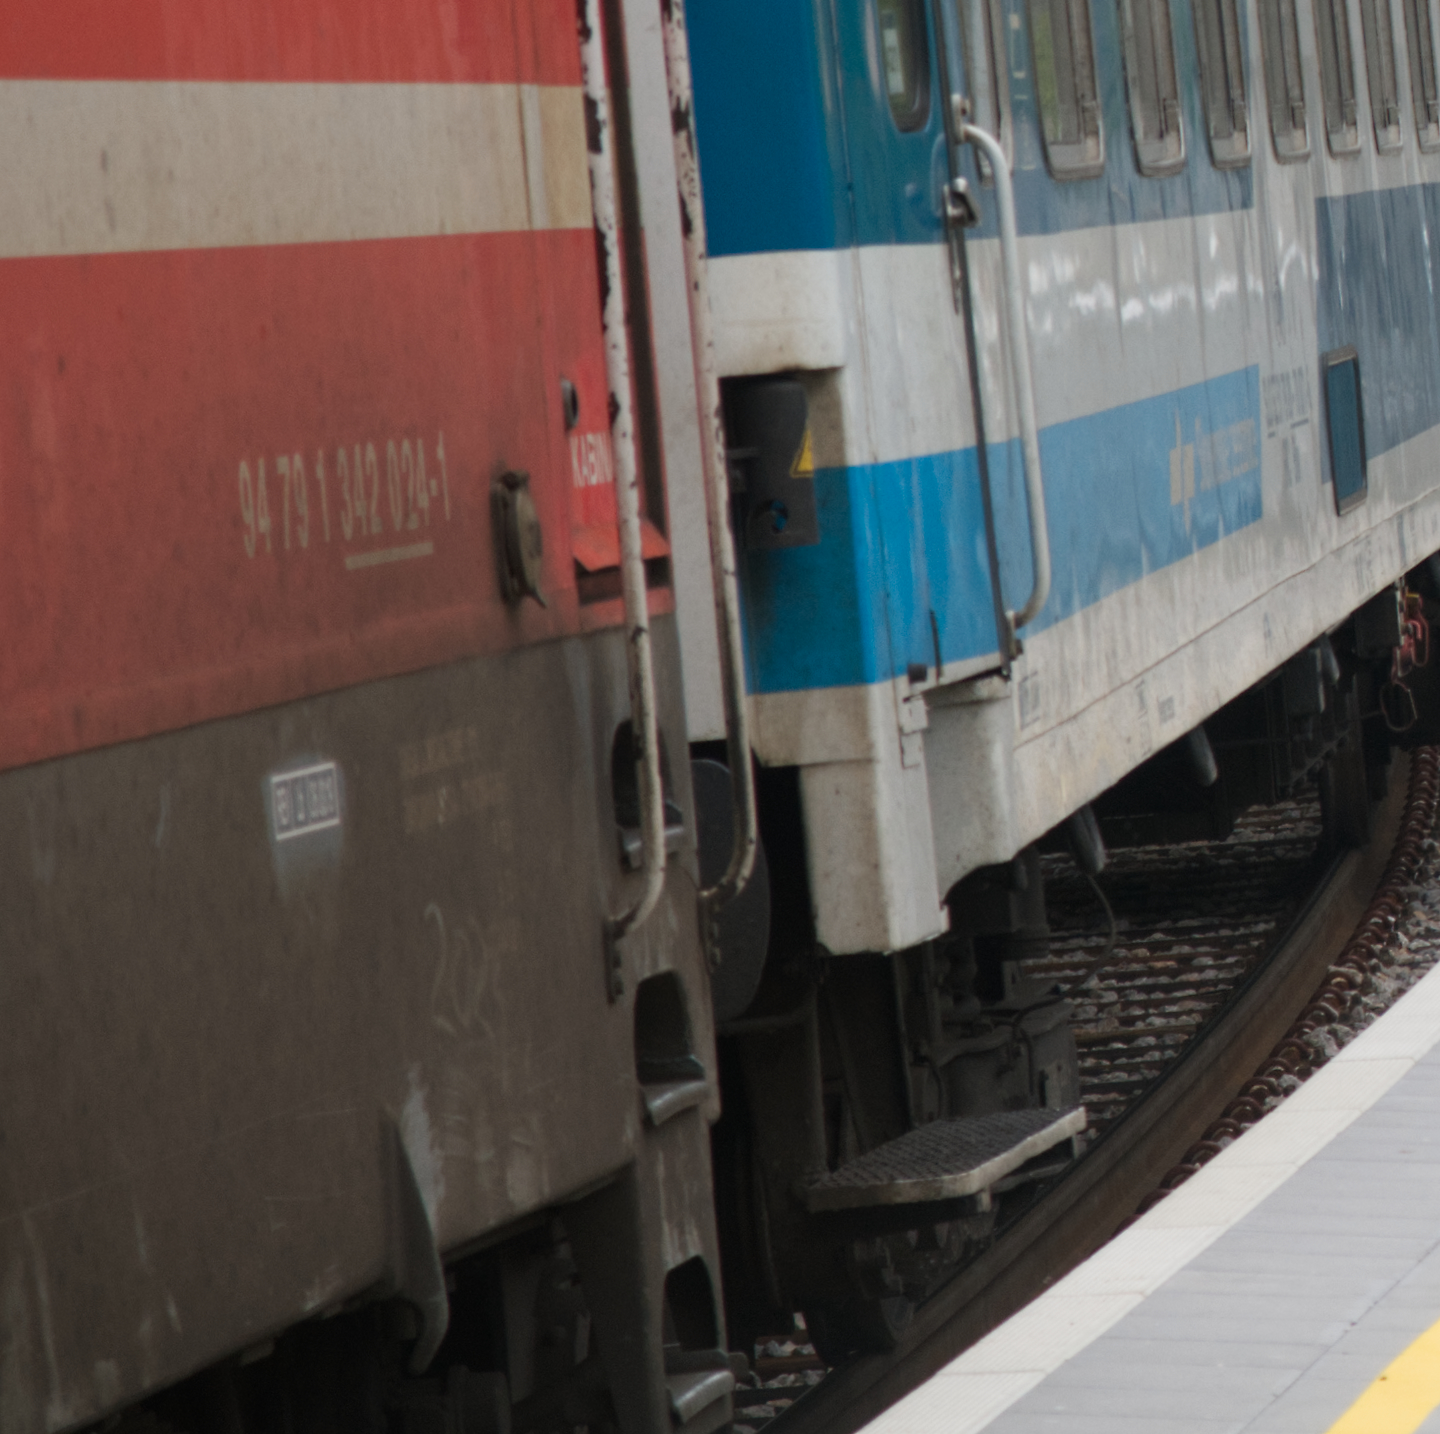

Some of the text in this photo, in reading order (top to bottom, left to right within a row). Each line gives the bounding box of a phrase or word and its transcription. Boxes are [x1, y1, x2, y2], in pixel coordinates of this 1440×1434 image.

[238, 459, 272, 559] 94
[276, 452, 310, 550] 79
[315, 447, 331, 544] 1
[336, 440, 383, 542] 342
[569, 431, 615, 489] KABIN
